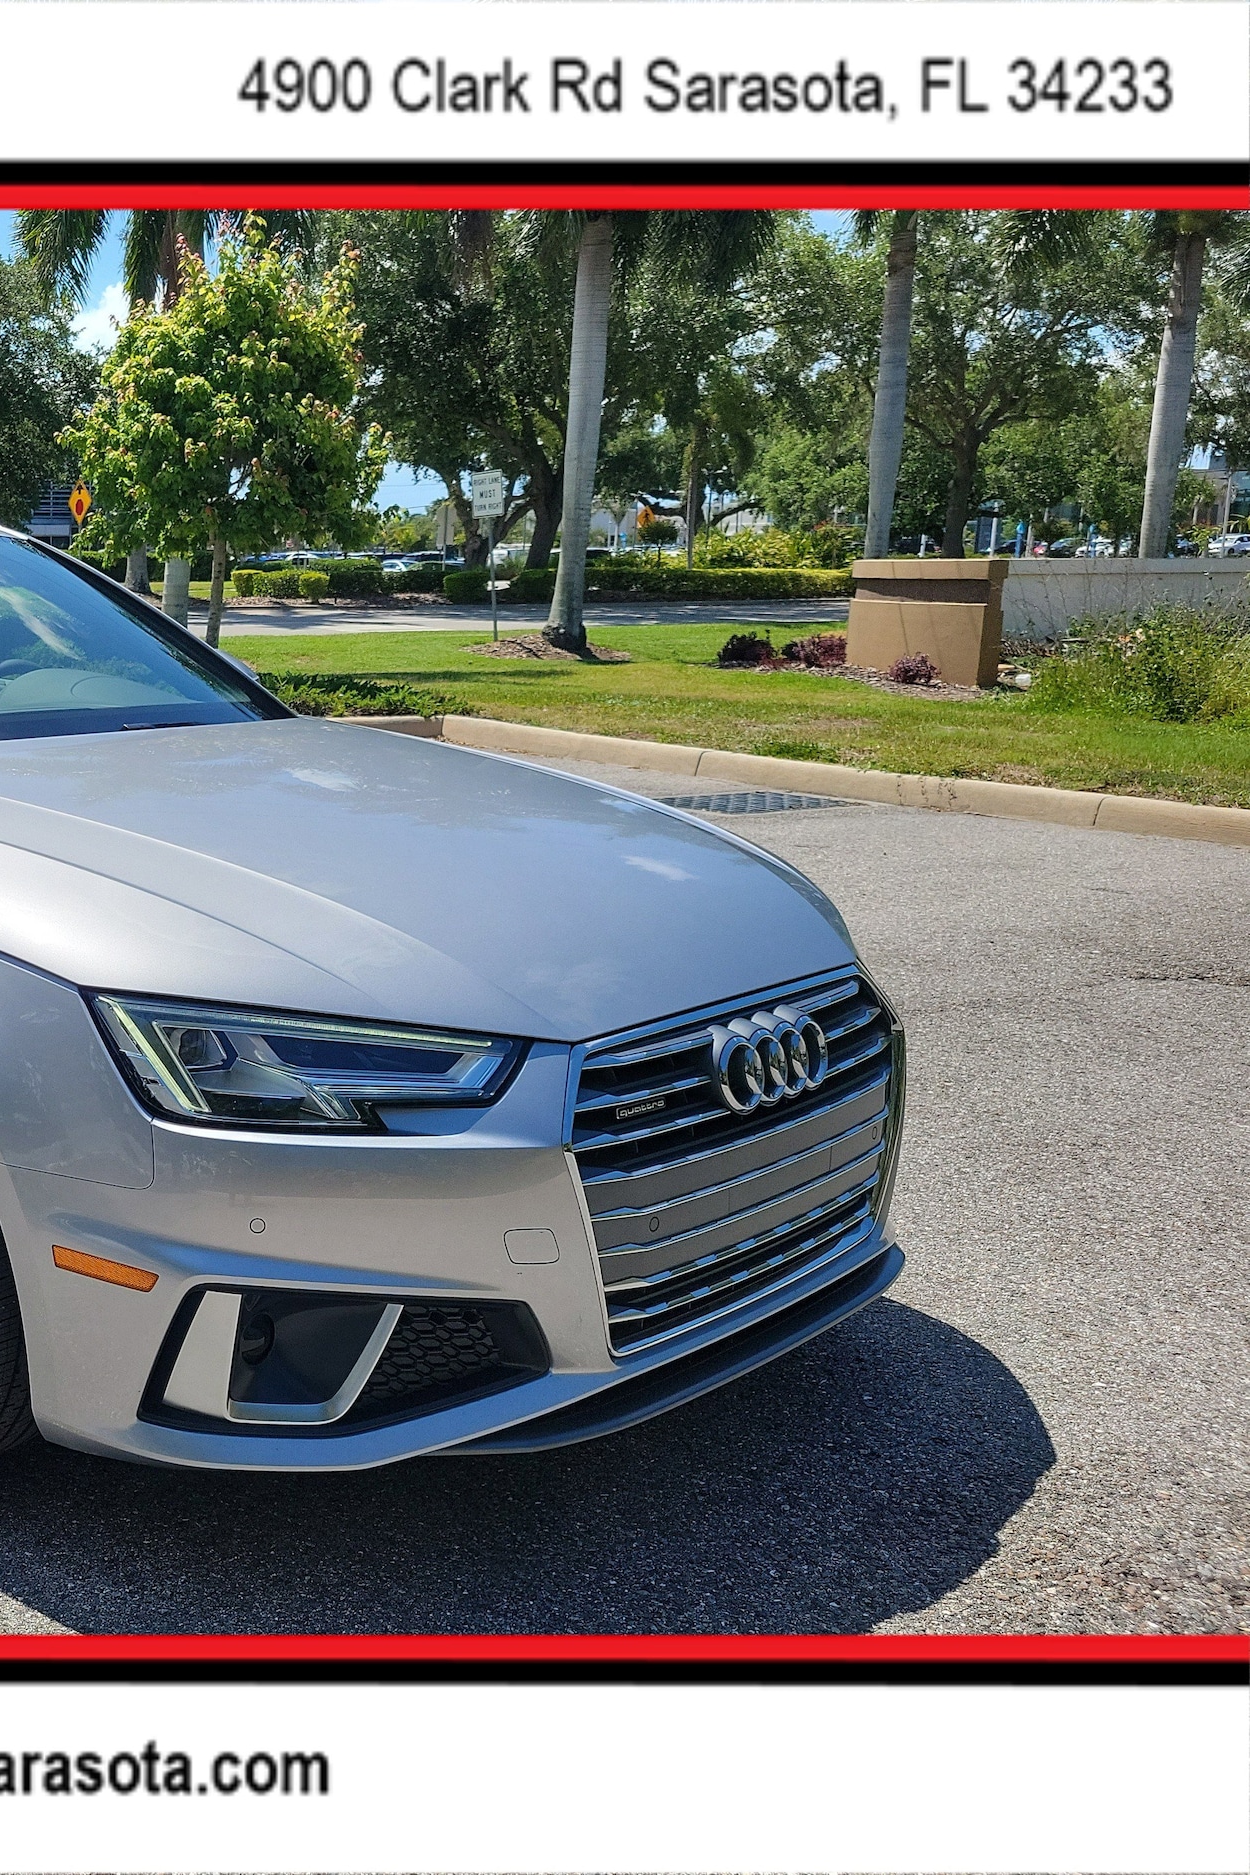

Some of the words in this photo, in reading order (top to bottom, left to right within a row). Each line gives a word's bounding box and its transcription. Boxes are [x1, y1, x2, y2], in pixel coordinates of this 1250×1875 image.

[488, 476, 501, 484] LANE
[479, 489, 496, 498] MUST
[619, 1100, 664, 1117] quattro
